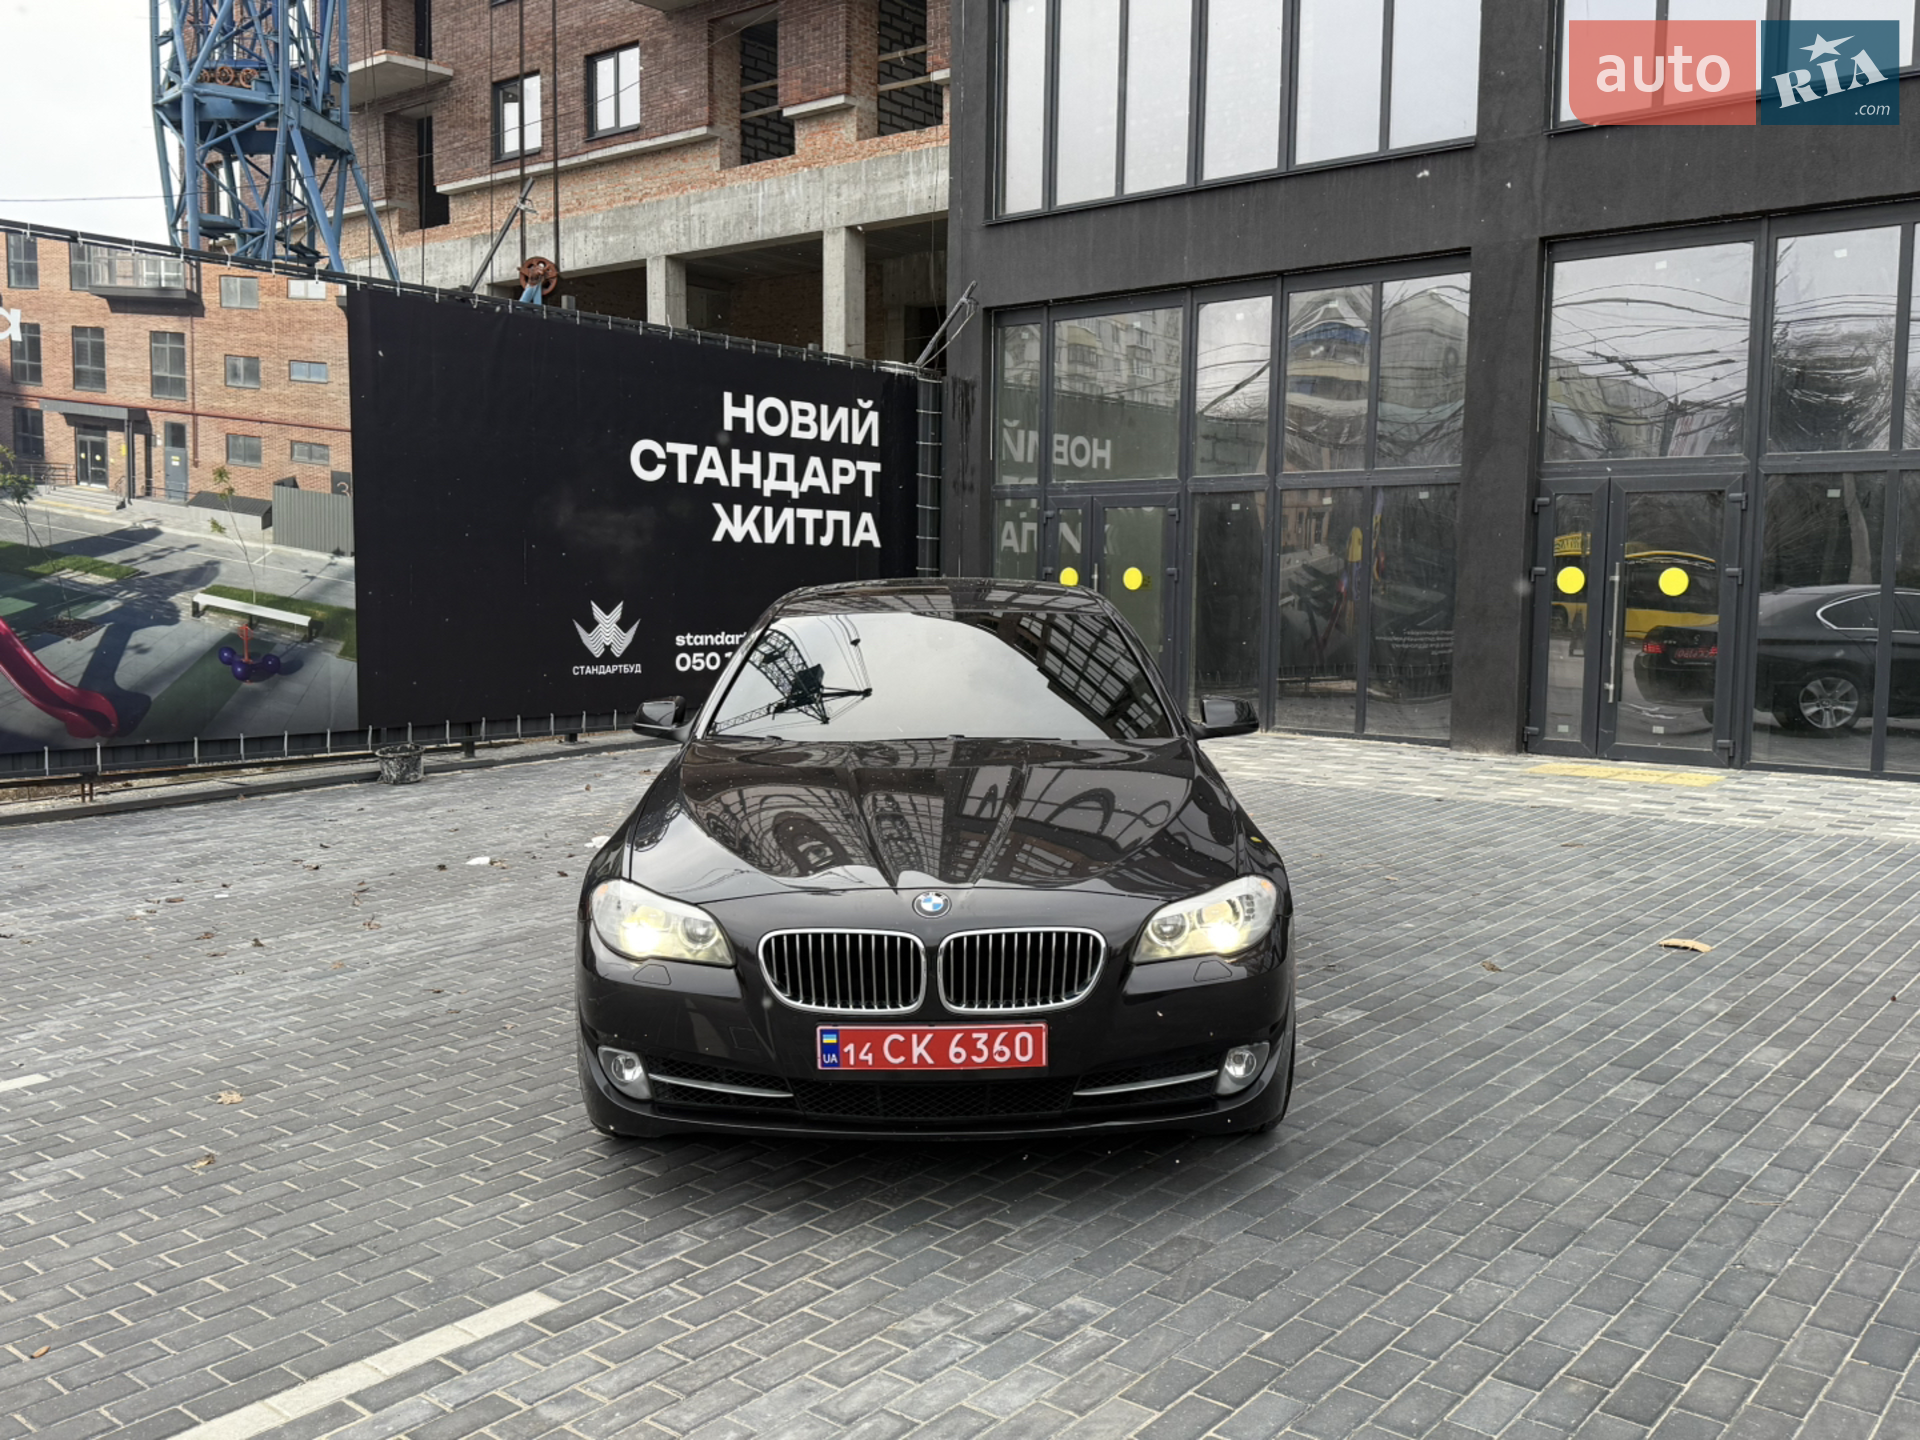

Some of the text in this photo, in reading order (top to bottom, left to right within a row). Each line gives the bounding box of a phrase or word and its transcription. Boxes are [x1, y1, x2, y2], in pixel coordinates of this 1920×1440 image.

[723, 391, 880, 448] НОВИЙ
[630, 439, 882, 500] СТАНДАРТ
[711, 502, 882, 549] ЖИТЛА
[675, 631, 748, 646] standar
[572, 663, 643, 676] СТАНДАРТБУД
[675, 651, 721, 672] 050
[822, 1053, 838, 1064] UA
[842, 1031, 1034, 1066] 14 CK 6360
